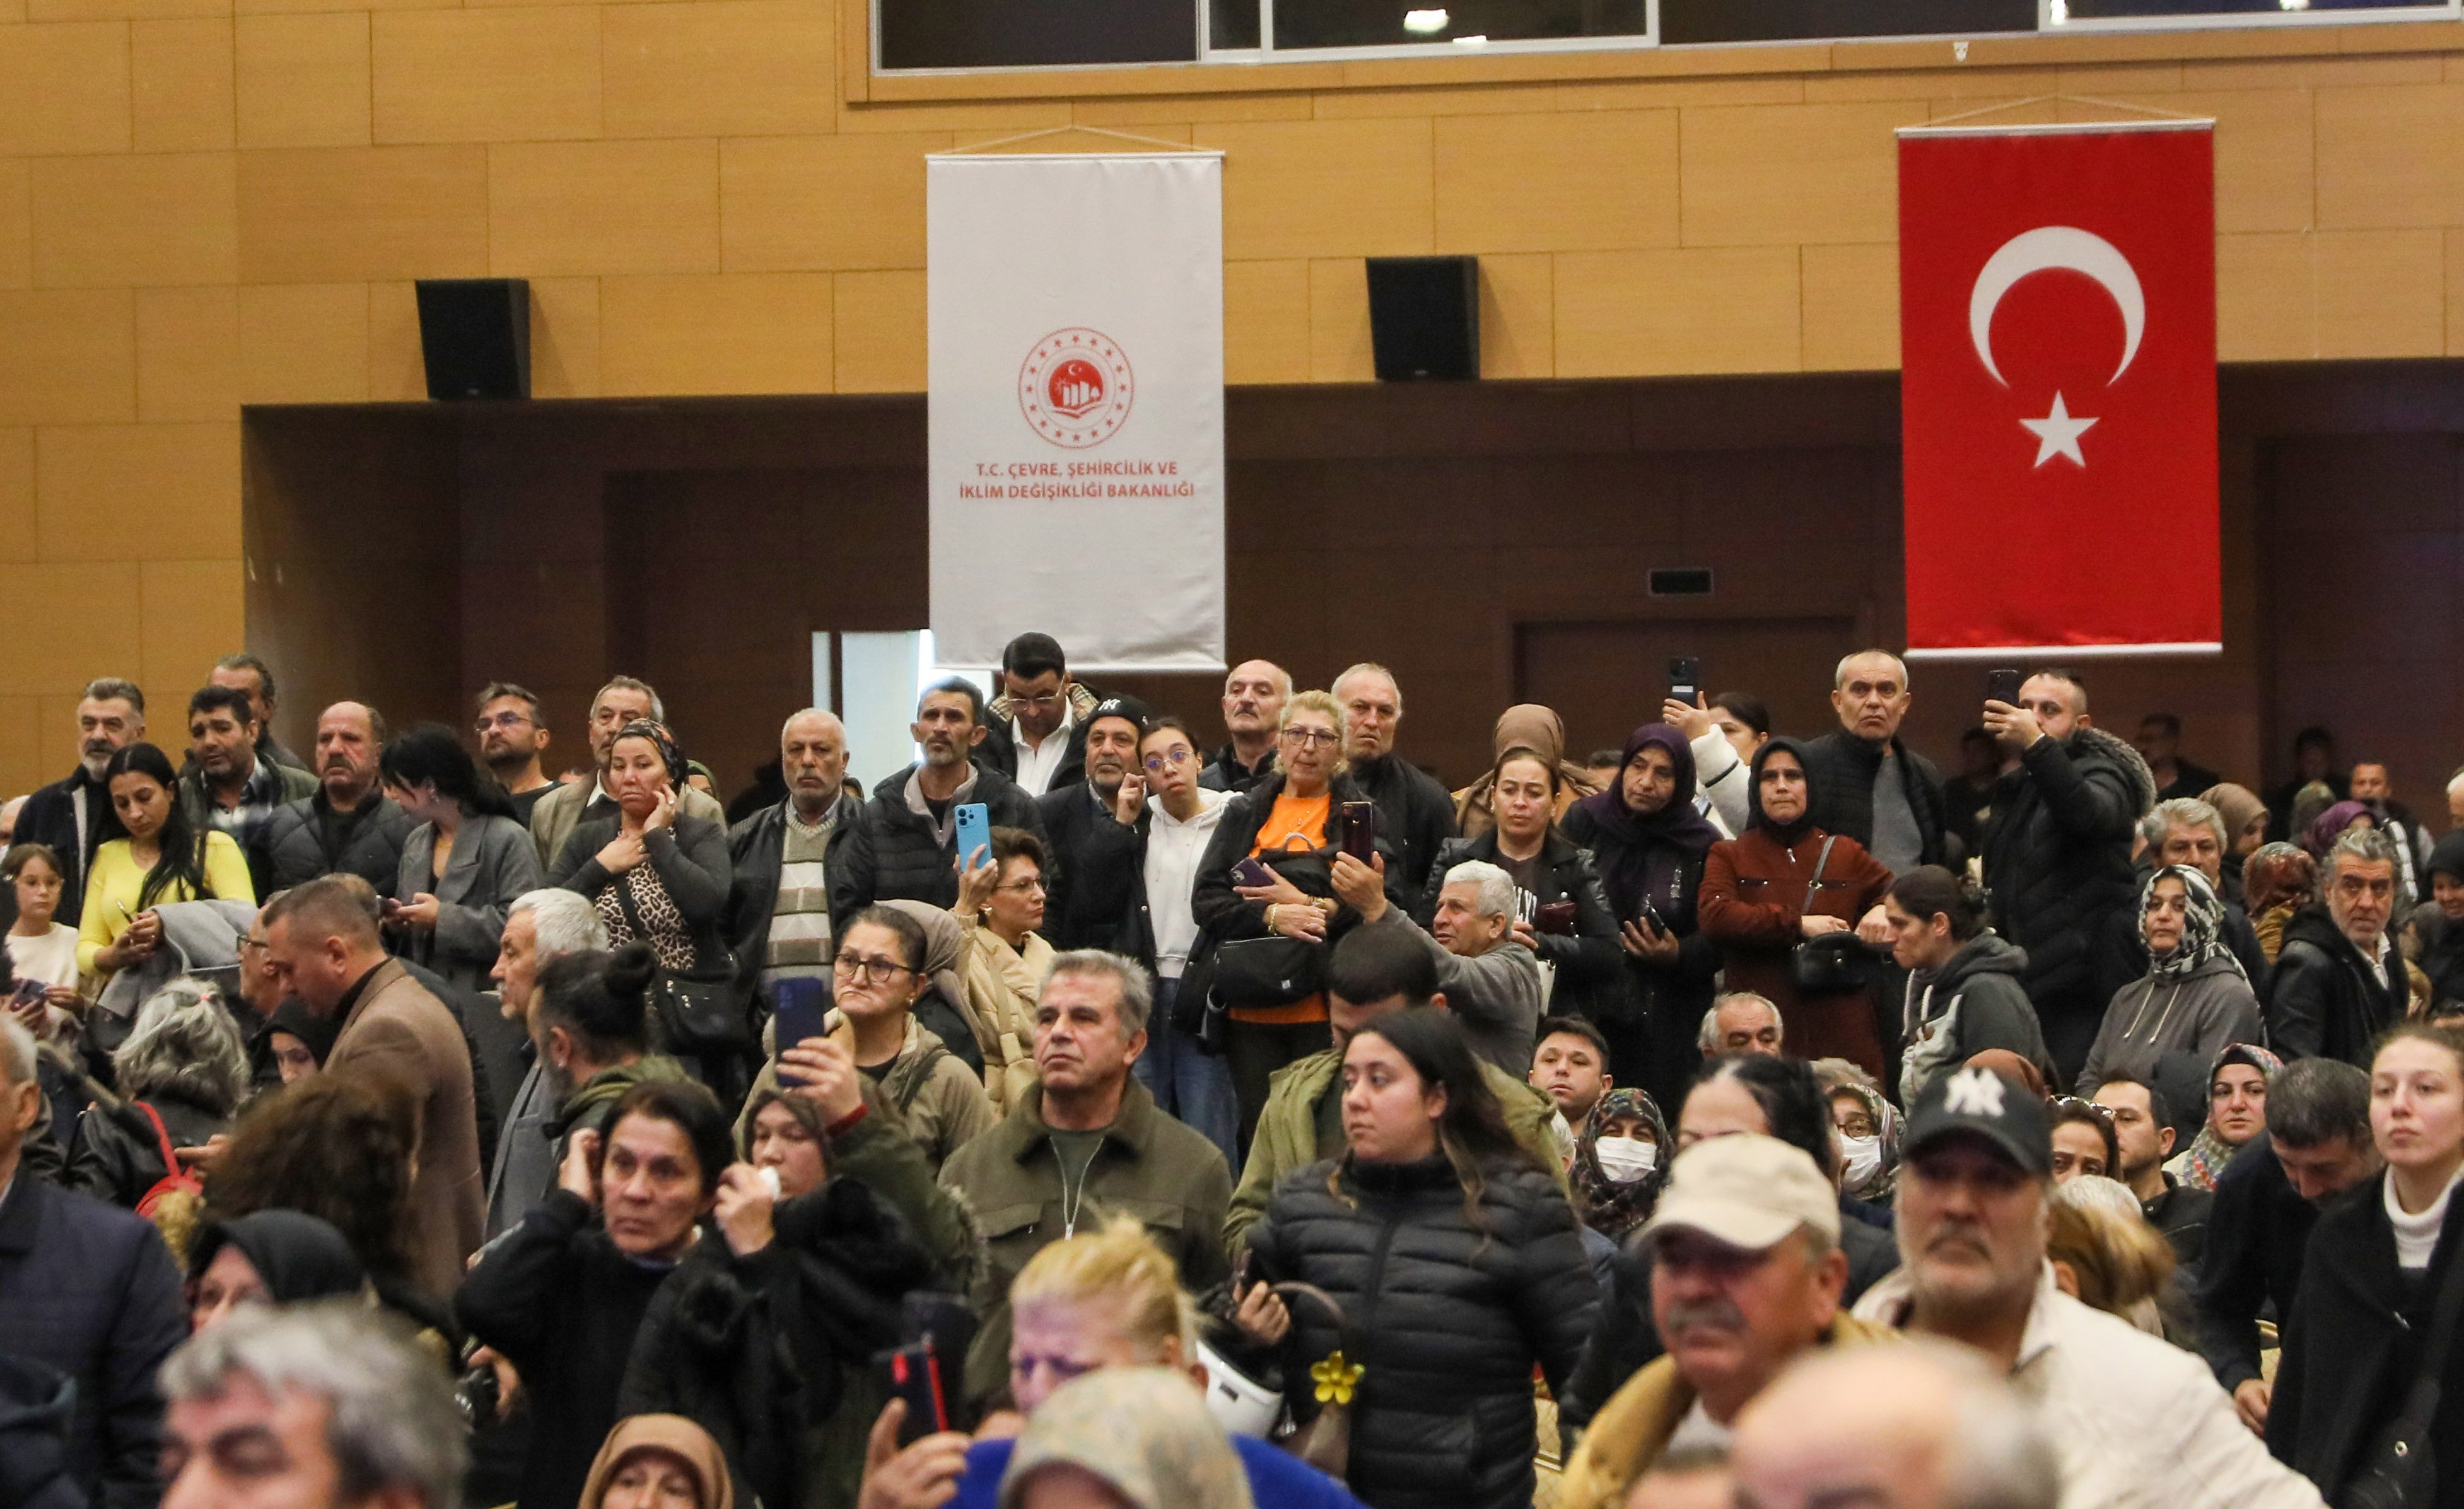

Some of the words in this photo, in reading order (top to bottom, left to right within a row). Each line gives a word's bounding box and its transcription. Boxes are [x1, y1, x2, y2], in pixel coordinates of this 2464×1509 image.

[976, 462, 1003, 476] T.C.
[1068, 459, 1153, 479] ŞEHİRCİLİK
[1157, 461, 1177, 475] VE
[959, 482, 1003, 499] İKLİM
[1008, 481, 1102, 502] DEĞİŞİKLİĞİ
[1107, 480, 1194, 498] BAKANLIĞI
